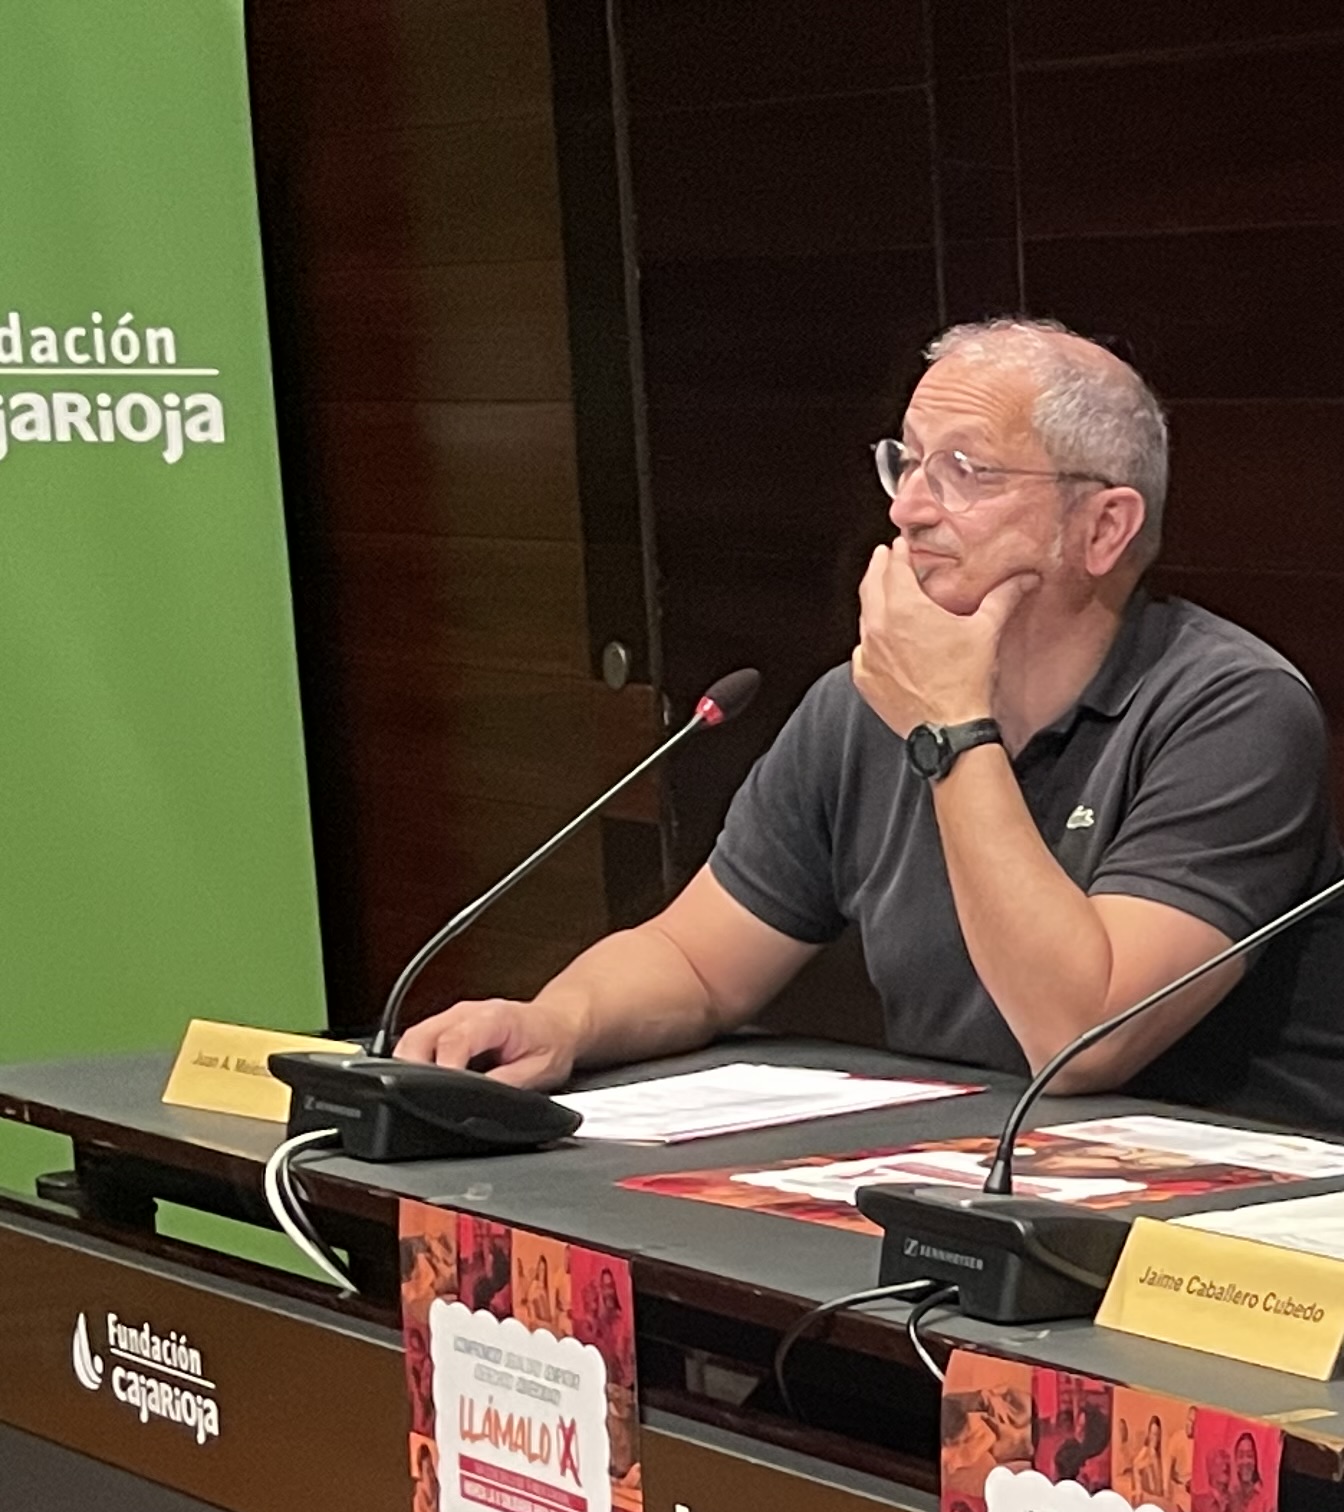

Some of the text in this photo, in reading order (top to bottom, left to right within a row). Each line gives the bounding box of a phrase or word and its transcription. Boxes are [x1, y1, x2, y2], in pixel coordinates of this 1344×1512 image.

[1139, 1266, 1325, 1323] Jaime Caballero Cubedo
[107, 1312, 202, 1376] Fundación
[460, 1394, 551, 1465] LLÁMALO
